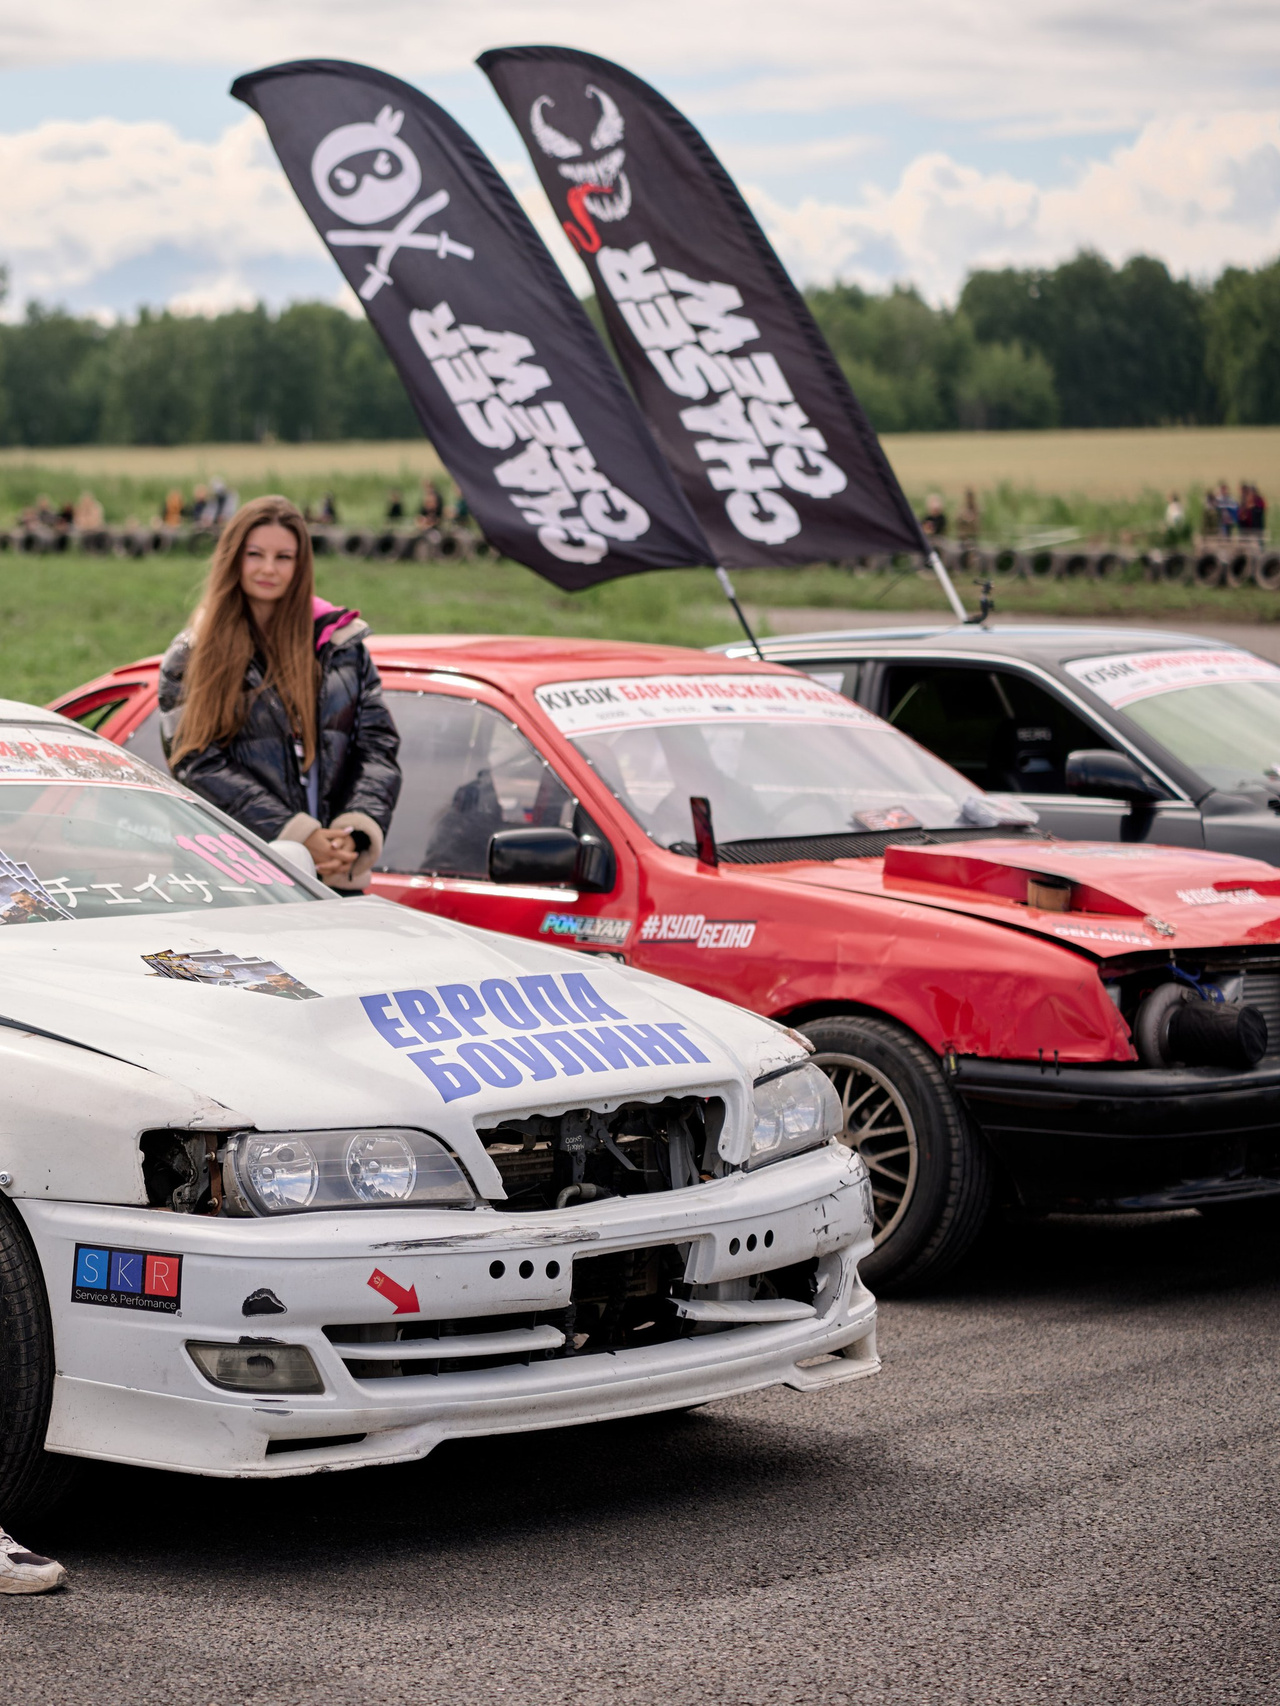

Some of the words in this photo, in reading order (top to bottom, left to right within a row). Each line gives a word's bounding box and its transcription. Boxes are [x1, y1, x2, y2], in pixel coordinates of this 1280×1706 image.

[596, 241, 801, 545] CHASER
[660, 266, 847, 498] CREW
[409, 301, 608, 564] CHASER
[459, 323, 650, 541] CREW
[538, 686, 619, 711] КУБОК
[617, 681, 783, 702] БАРНАУЛЬСКОЙ
[359, 972, 629, 1050] ЕВРОПА
[407, 1022, 712, 1104] БОУЛИНГ
[75, 1289, 109, 1303] Service
[109, 1293, 118, 1304] &
[120, 1294, 177, 1311] Perfomance
[82, 1252, 170, 1292] SKR
